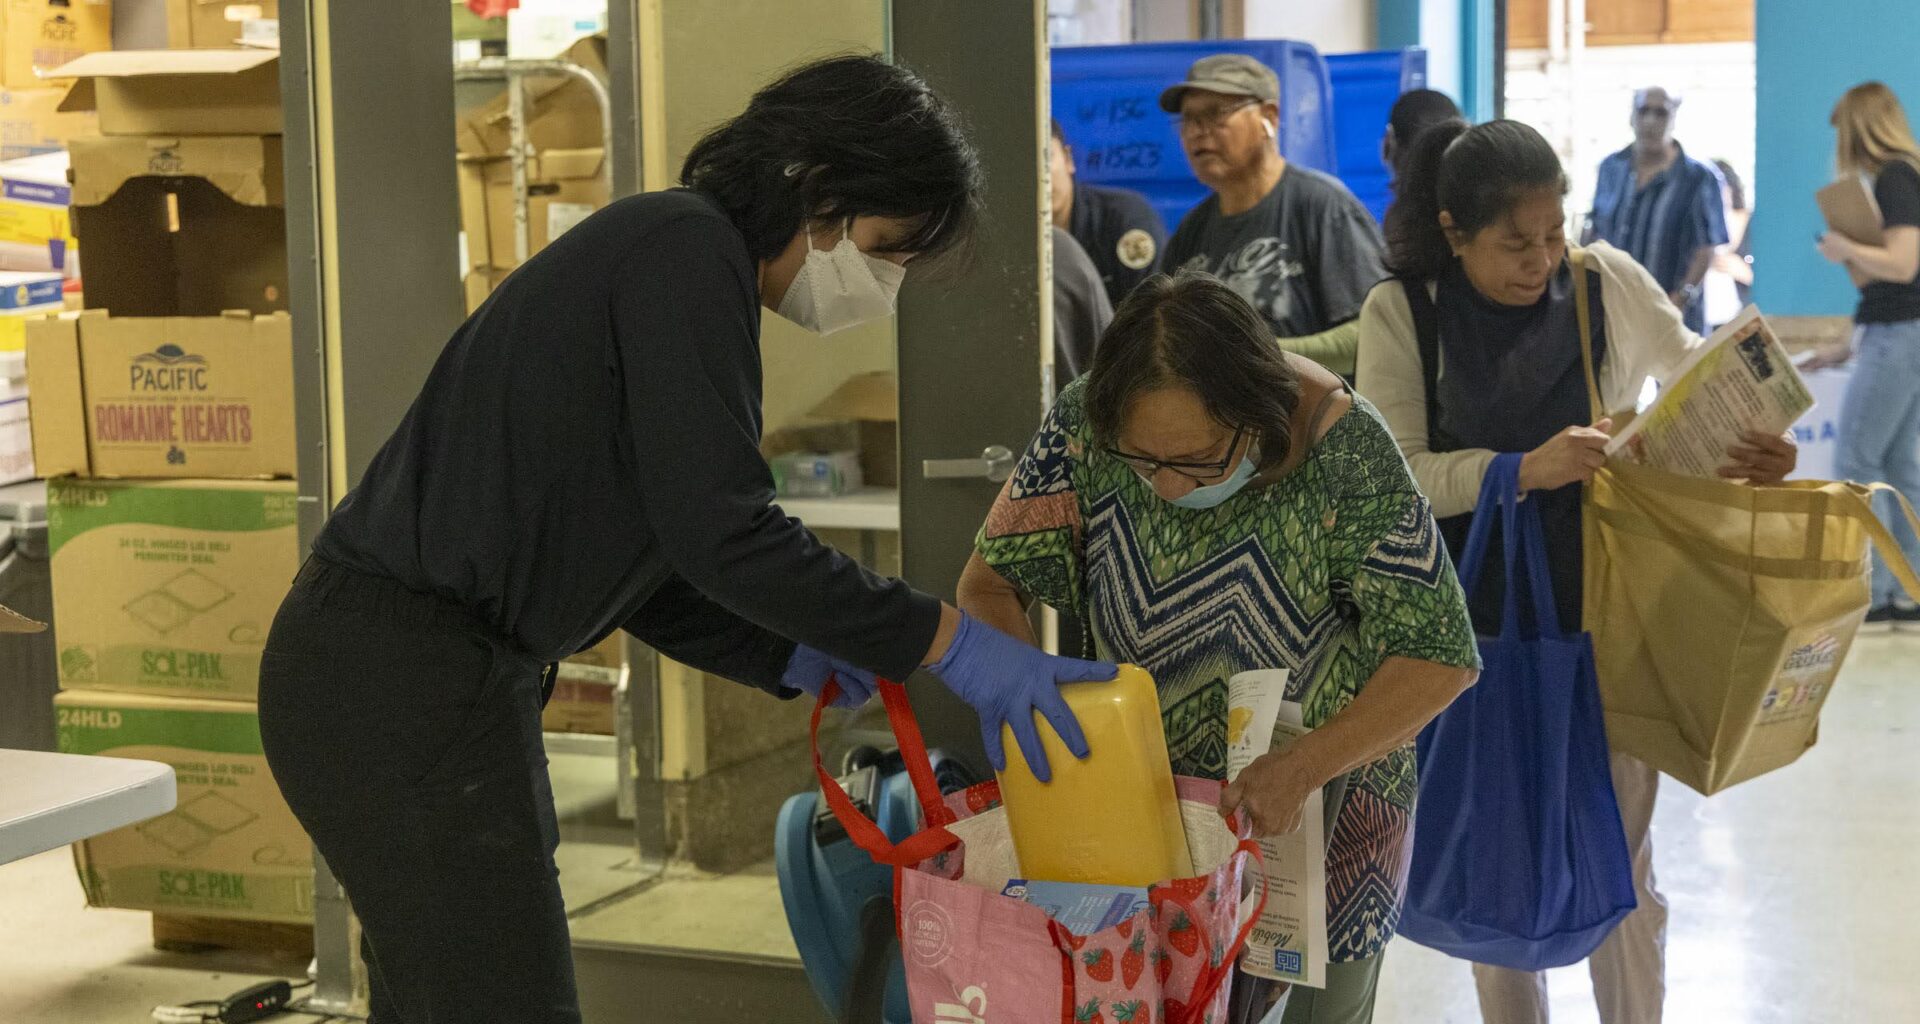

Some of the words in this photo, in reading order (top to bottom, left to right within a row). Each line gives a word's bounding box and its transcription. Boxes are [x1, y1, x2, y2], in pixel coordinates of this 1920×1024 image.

[130, 365, 208, 391] PACIFIC
[95, 404, 178, 443] ROMAINE
[182, 404, 252, 444] HEARTS
[134, 551, 187, 562] PERIMETER
[190, 552, 214, 563] SEAL
[141, 650, 224, 680] SOL-PAK
[57, 709, 122, 729] 24HLD
[159, 870, 246, 898] SOL-PAK
[918, 919, 941, 931] 100%
[1251, 928, 1293, 948] Mobile
